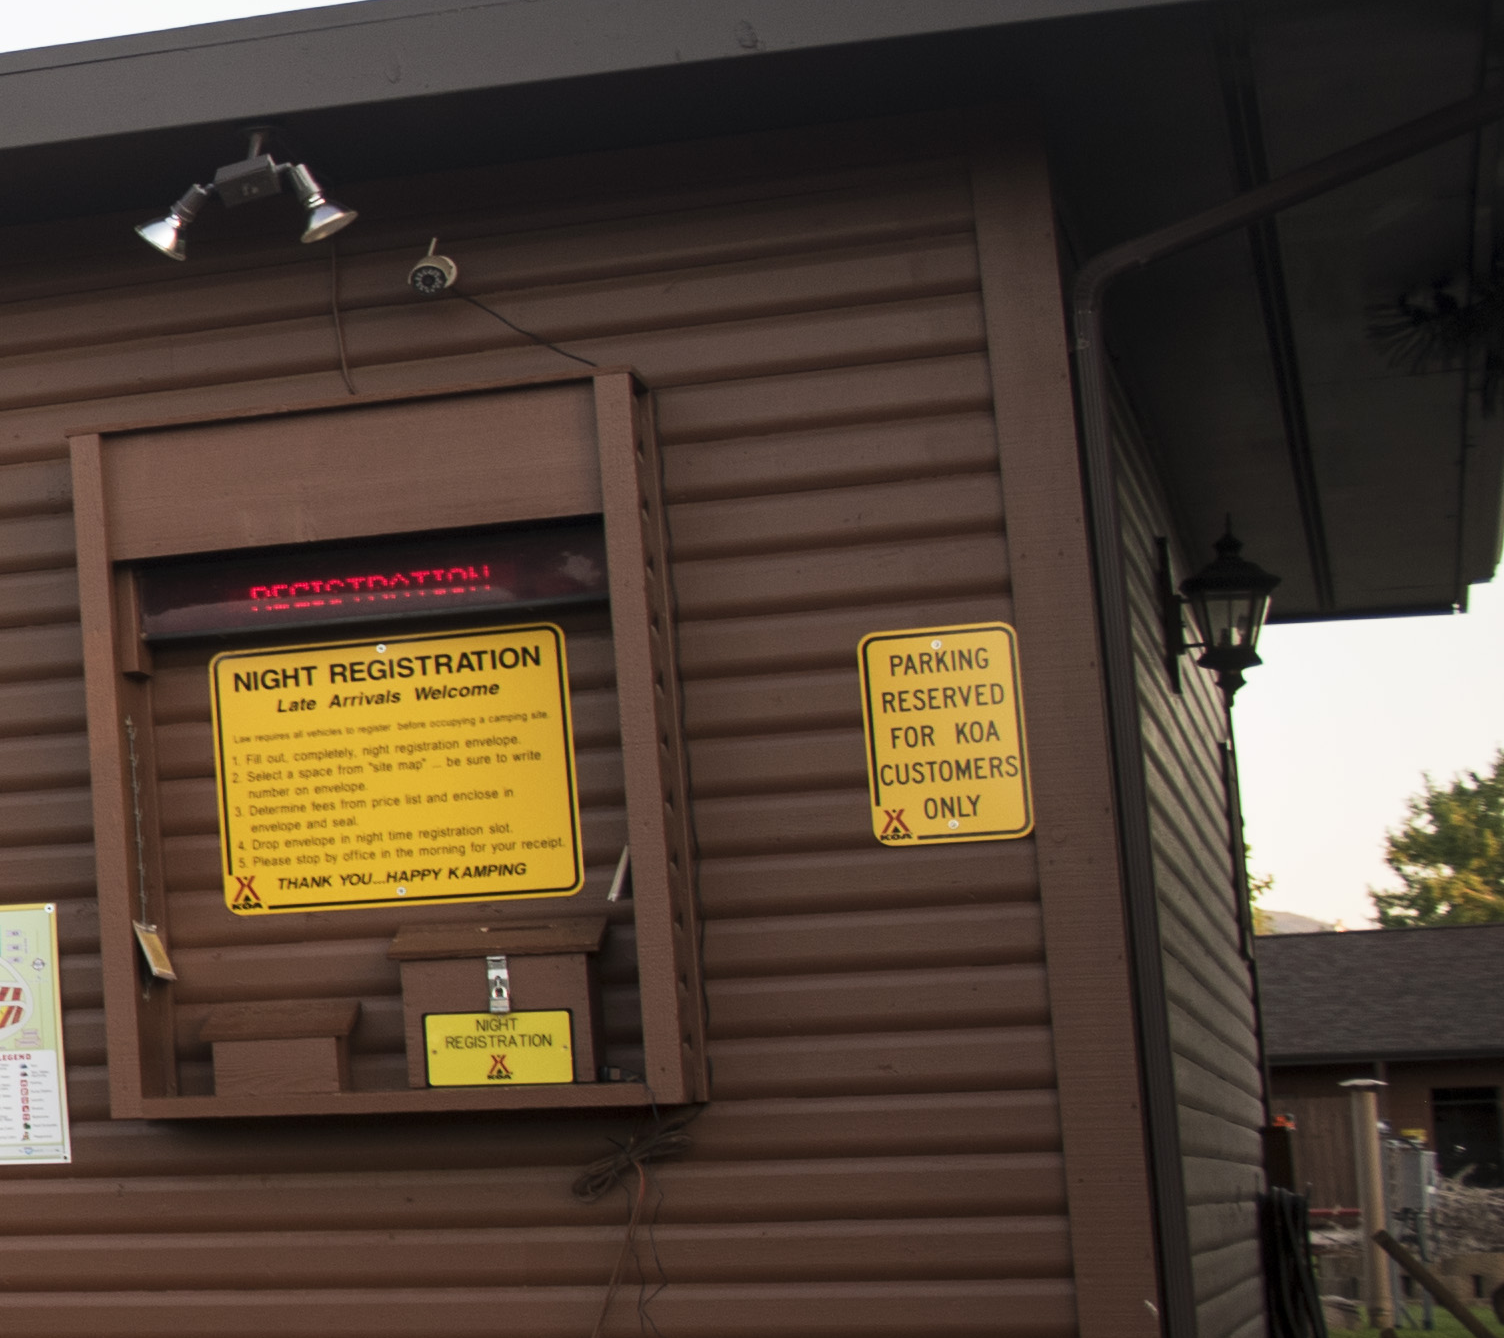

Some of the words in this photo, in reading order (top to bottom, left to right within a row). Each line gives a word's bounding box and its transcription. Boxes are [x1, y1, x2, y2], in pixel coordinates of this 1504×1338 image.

[233, 665, 317, 691] NIGHT
[329, 646, 541, 683] REGISTRATION
[889, 648, 990, 676] PARKING
[276, 696, 316, 713] Late
[328, 689, 400, 708] Arrivals
[414, 681, 499, 701] Welcome
[882, 683, 1005, 713] RESERVED
[891, 725, 935, 749] FOR
[955, 720, 1000, 744] KOA
[233, 756, 239, 766] 1.
[245, 754, 262, 765] Fill
[362, 744, 389, 758] night
[394, 739, 459, 755] registration
[247, 770, 282, 782] Select
[287, 771, 293, 779] a
[298, 768, 332, 780] space
[337, 764, 363, 775] from
[446, 756, 460, 767] be
[466, 756, 490, 765] sure
[496, 752, 507, 763] to
[512, 750, 541, 762] write
[880, 755, 1019, 786] CUSTOMERS
[248, 786, 289, 799] number
[295, 787, 308, 795] on
[249, 802, 307, 816] Determine
[312, 800, 335, 811] fees
[340, 798, 366, 809] from
[371, 795, 400, 809] price
[405, 794, 420, 804] list
[426, 792, 447, 802] and
[452, 788, 498, 800] enclose
[504, 787, 513, 797] in
[923, 794, 981, 820] ONLY
[250, 820, 301, 835] envelope
[306, 818, 327, 829] and
[252, 839, 279, 852] Drop
[284, 835, 335, 850] envelope
[340, 834, 350, 844] in
[355, 832, 383, 845] night
[388, 829, 412, 841] time
[418, 824, 483, 840] registration
[253, 855, 291, 868] Please
[297, 854, 320, 867] stop
[324, 852, 338, 865] by
[342, 849, 375, 861] office
[381, 848, 390, 859] in
[396, 847, 413, 858] the
[418, 843, 465, 858] morning
[470, 842, 486, 852] for
[491, 842, 516, 853] your
[278, 876, 332, 891] THANK
[448, 862, 527, 880] KAMPING
[476, 1018, 518, 1032] NIGHT
[445, 1033, 552, 1050] REGISTRATION
